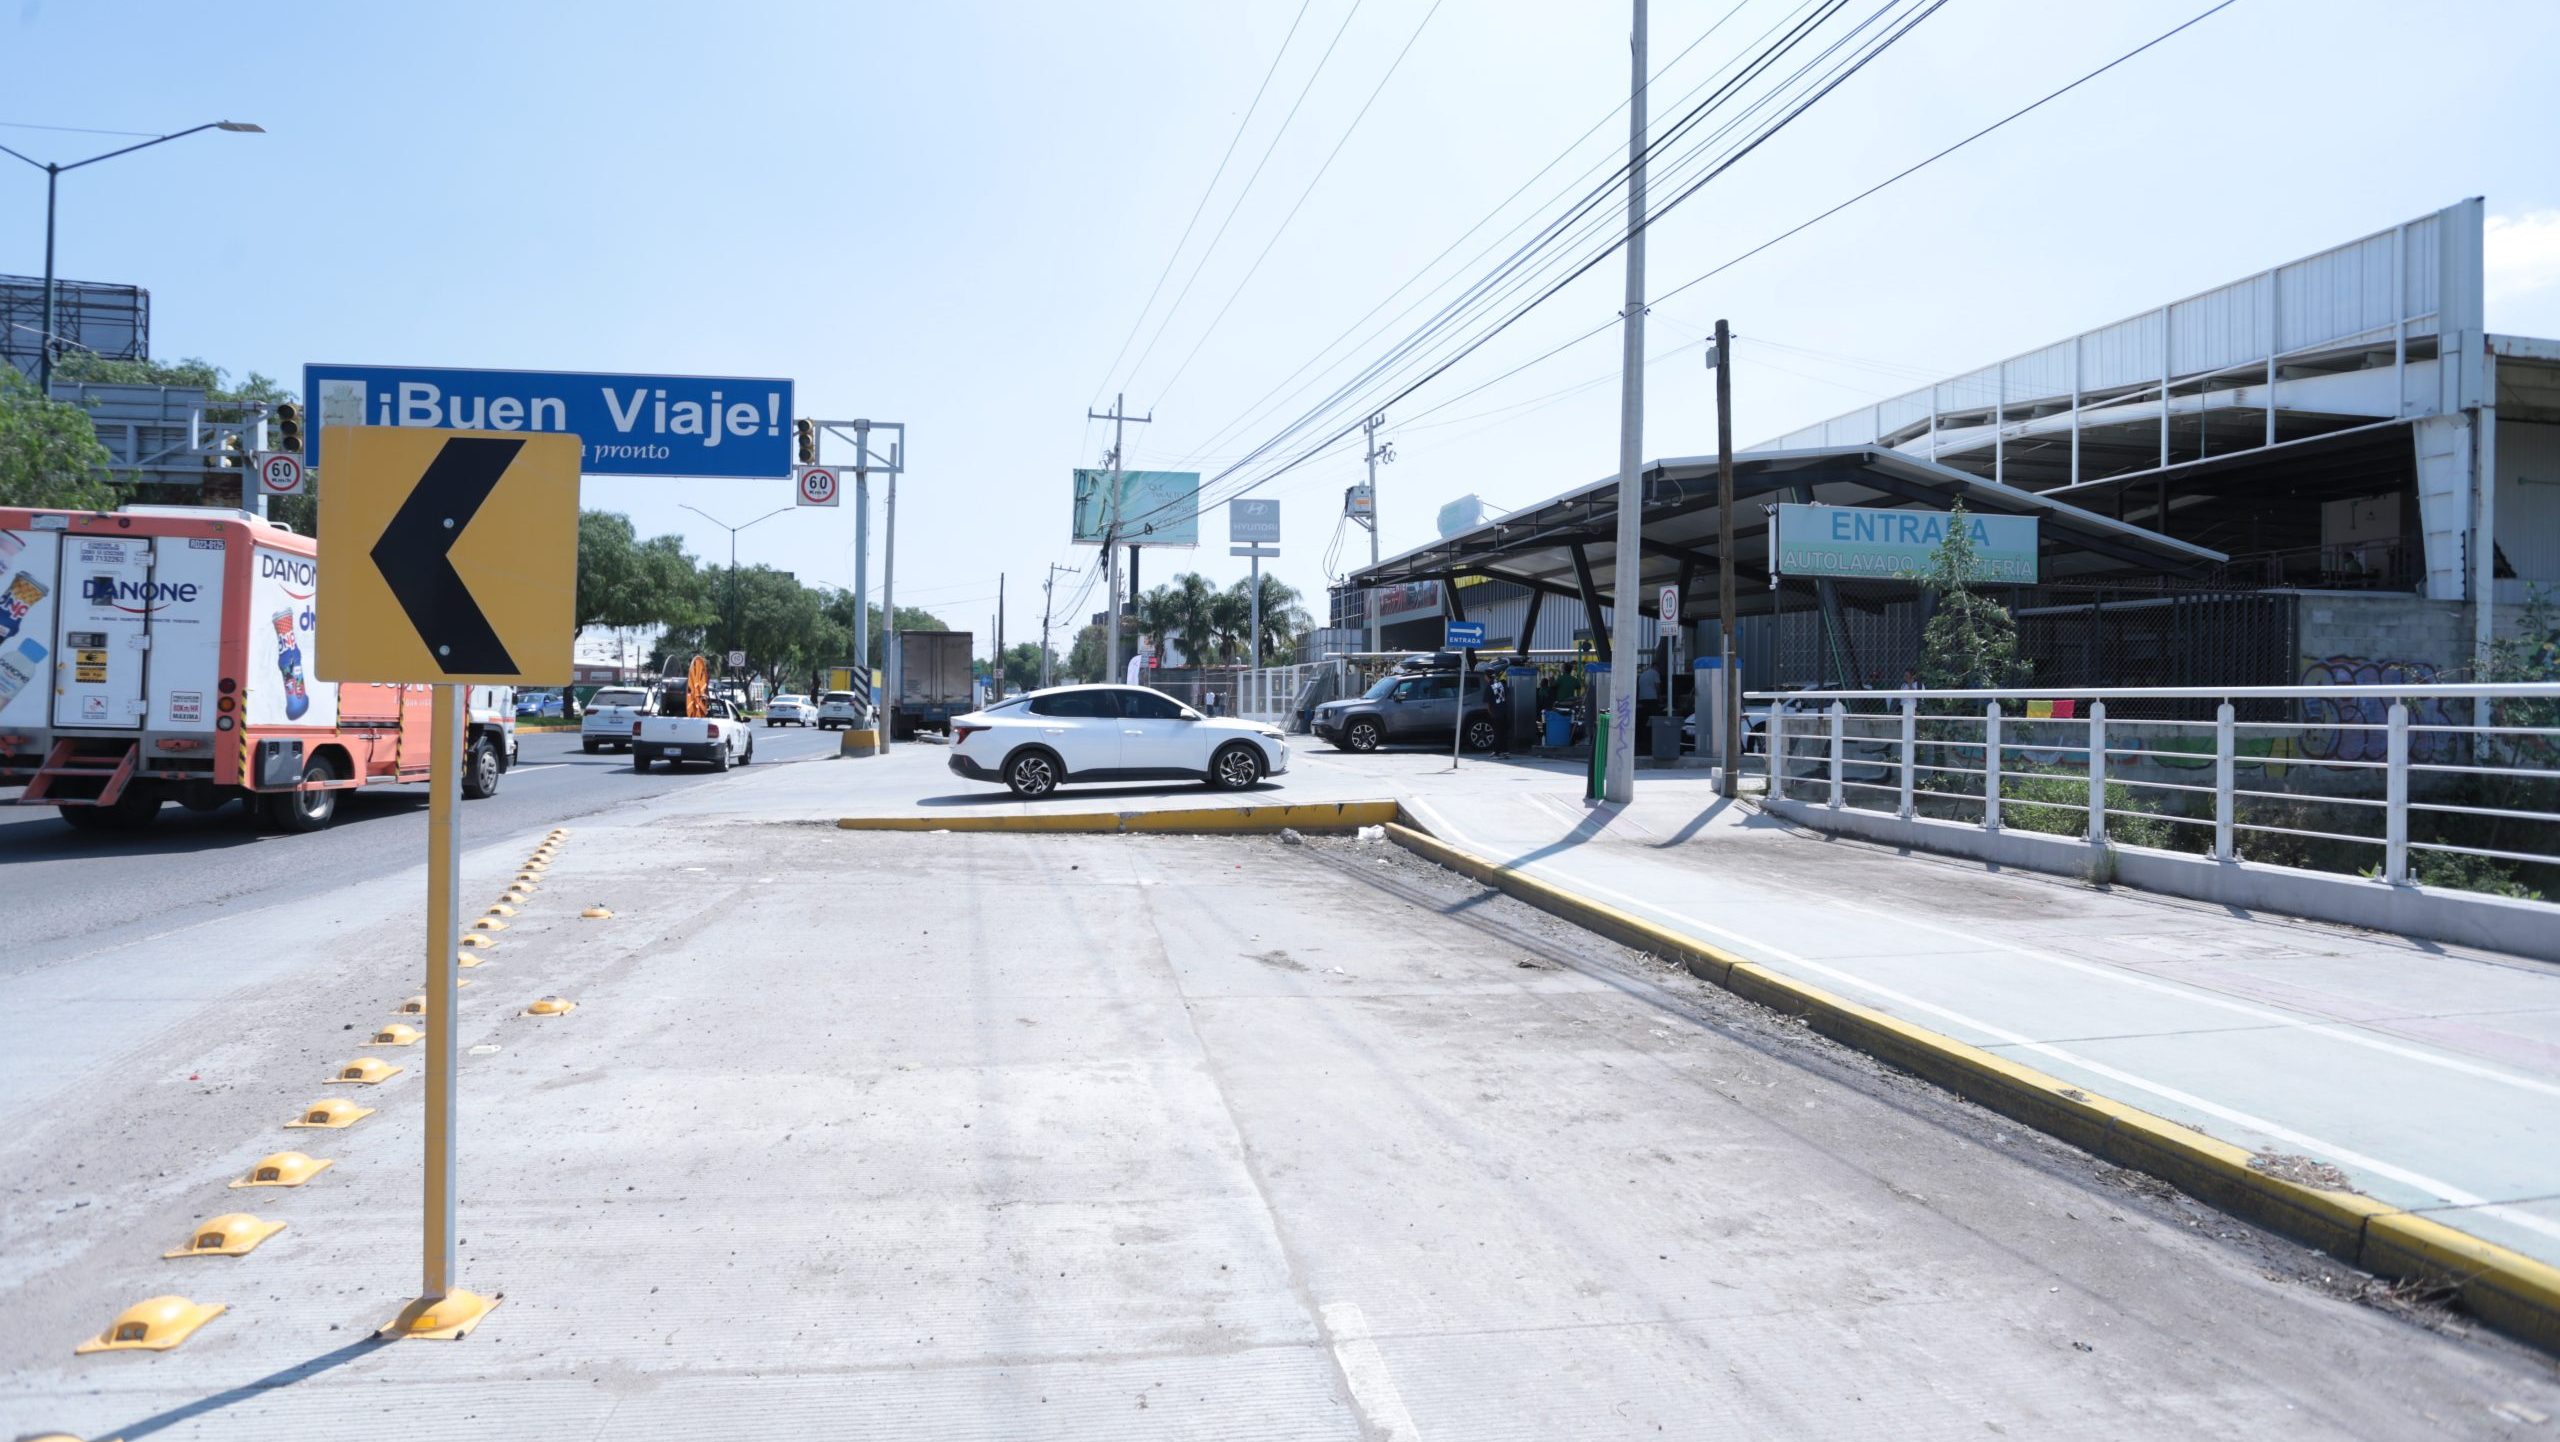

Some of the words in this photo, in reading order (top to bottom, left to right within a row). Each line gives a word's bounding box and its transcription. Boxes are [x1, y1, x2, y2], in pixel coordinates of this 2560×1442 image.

[602, 387, 780, 447] Viaje!
[594, 444, 670, 463] pronto
[272, 463, 291, 477] 60
[810, 476, 827, 489] 60
[1784, 551, 1914, 572] AUTOLAVADO
